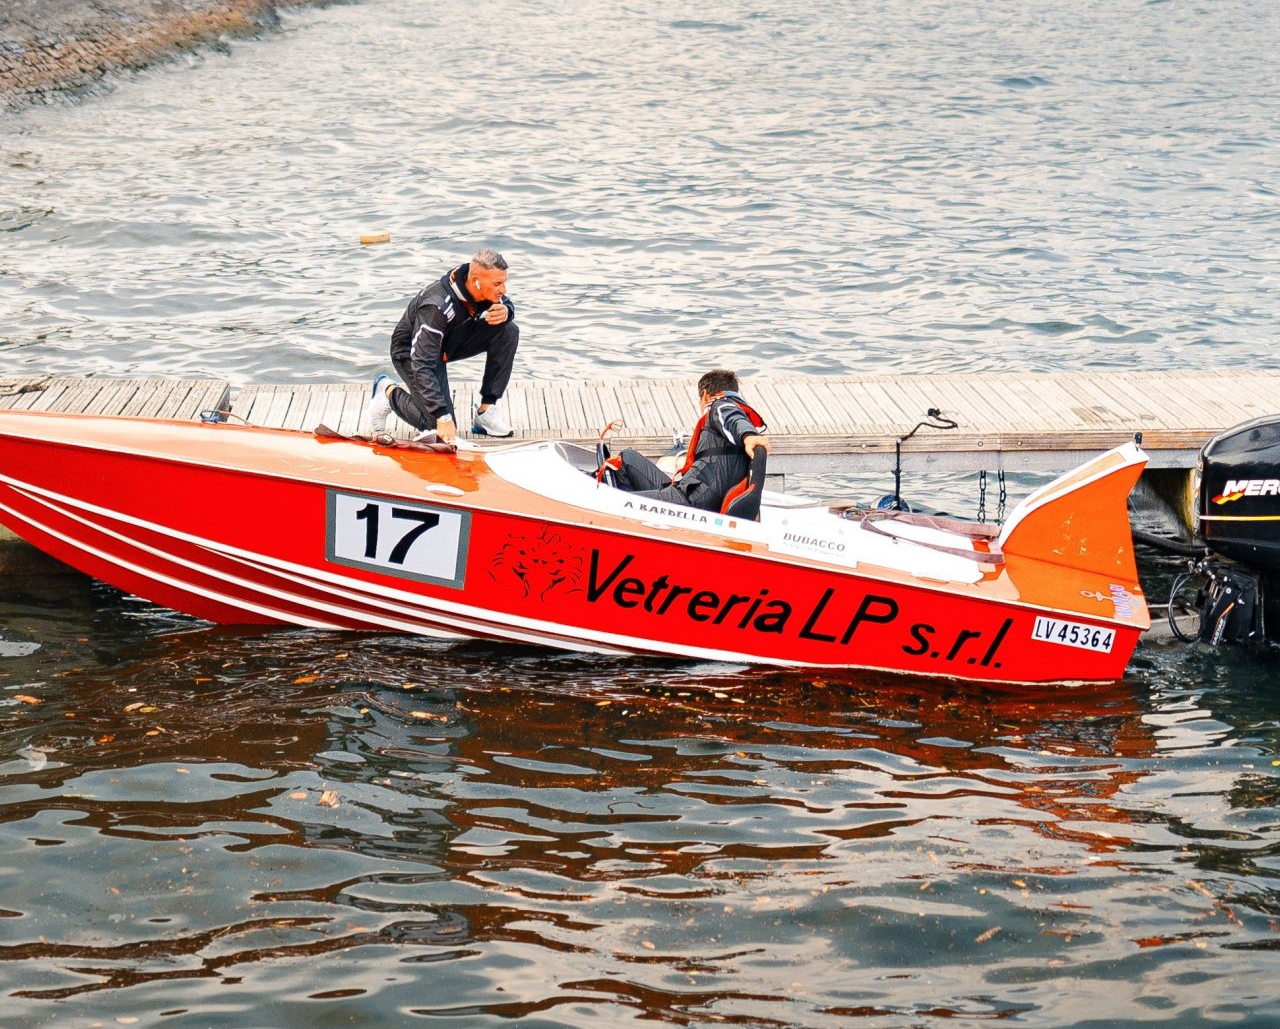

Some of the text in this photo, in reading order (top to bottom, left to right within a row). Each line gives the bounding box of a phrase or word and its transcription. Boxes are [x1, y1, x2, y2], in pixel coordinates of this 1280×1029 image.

[356, 503, 440, 565] 17
[783, 532, 846, 552] BUBACCO
[587, 548, 1014, 669] Vetreria LP s.r.l.
[1035, 619, 1112, 650] LV 45364
